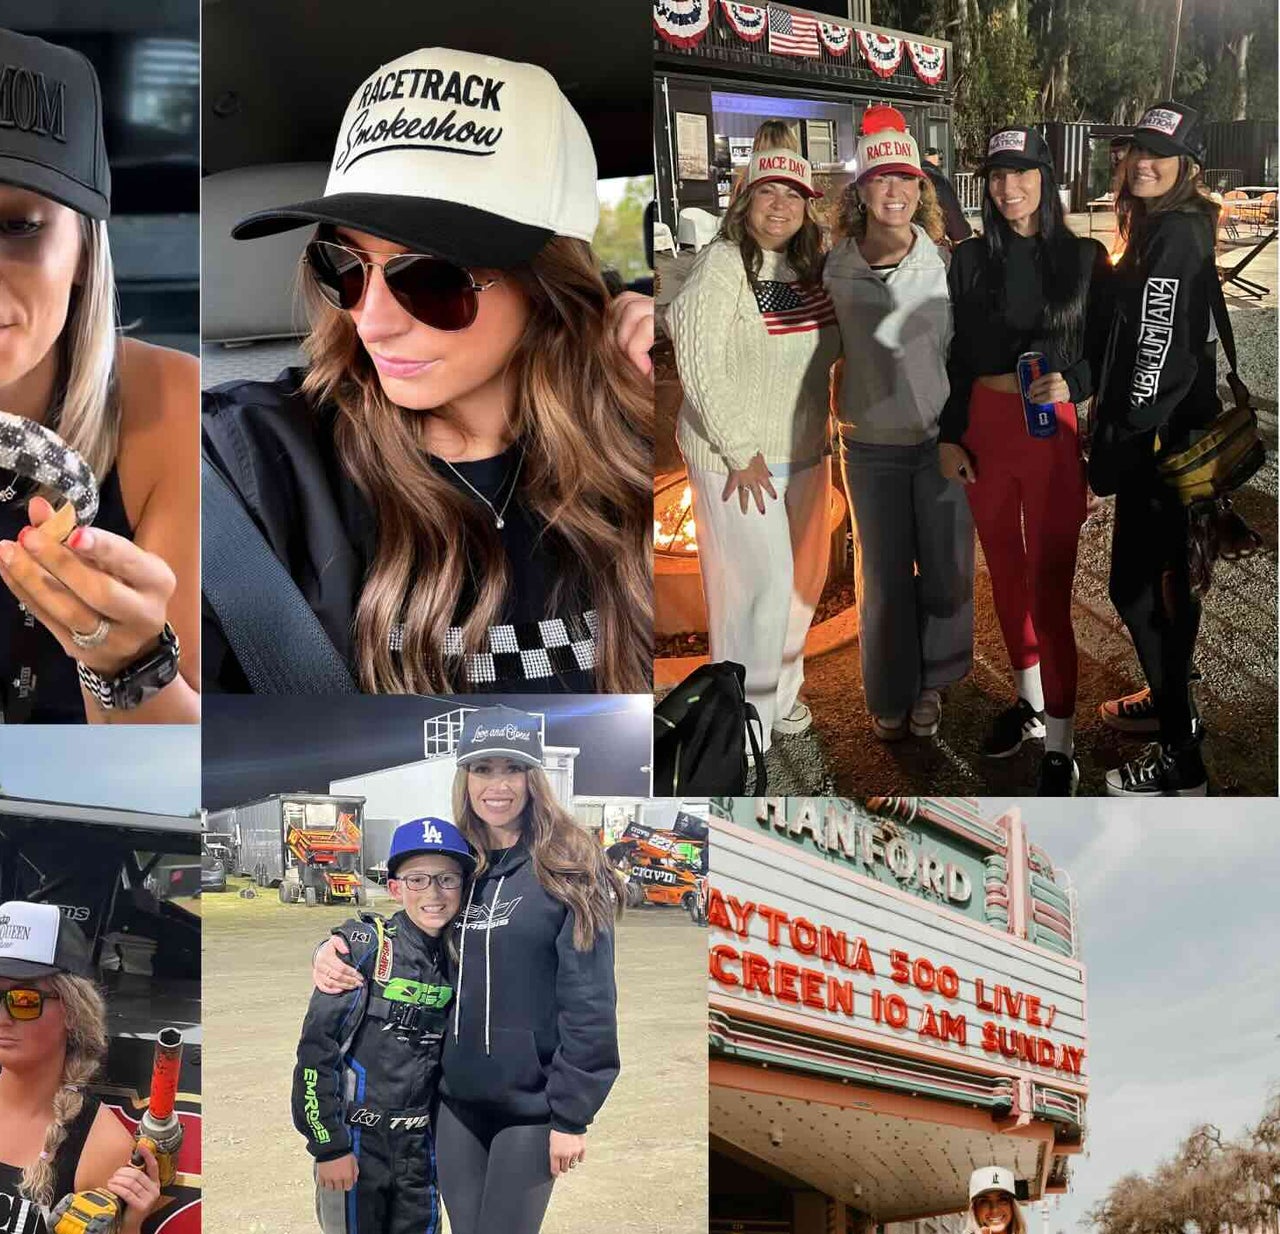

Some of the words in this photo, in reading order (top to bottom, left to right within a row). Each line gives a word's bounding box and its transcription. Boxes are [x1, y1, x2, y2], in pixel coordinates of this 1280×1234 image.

[357, 69, 504, 112] RACETRACK
[337, 107, 503, 168] Smokeshow
[866, 141, 892, 159] RACE
[894, 142, 911, 157] DAY
[759, 156, 787, 171] RACE
[789, 158, 805, 177] DAY
[422, 820, 443, 844] LA
[754, 797, 974, 904] HANFORD
[377, 940, 391, 977] SIMPSON
[889, 948, 959, 999] 500
[871, 988, 908, 1029] 10
[920, 1003, 967, 1046] AM
[981, 1021, 1085, 1075] SUNDAY
